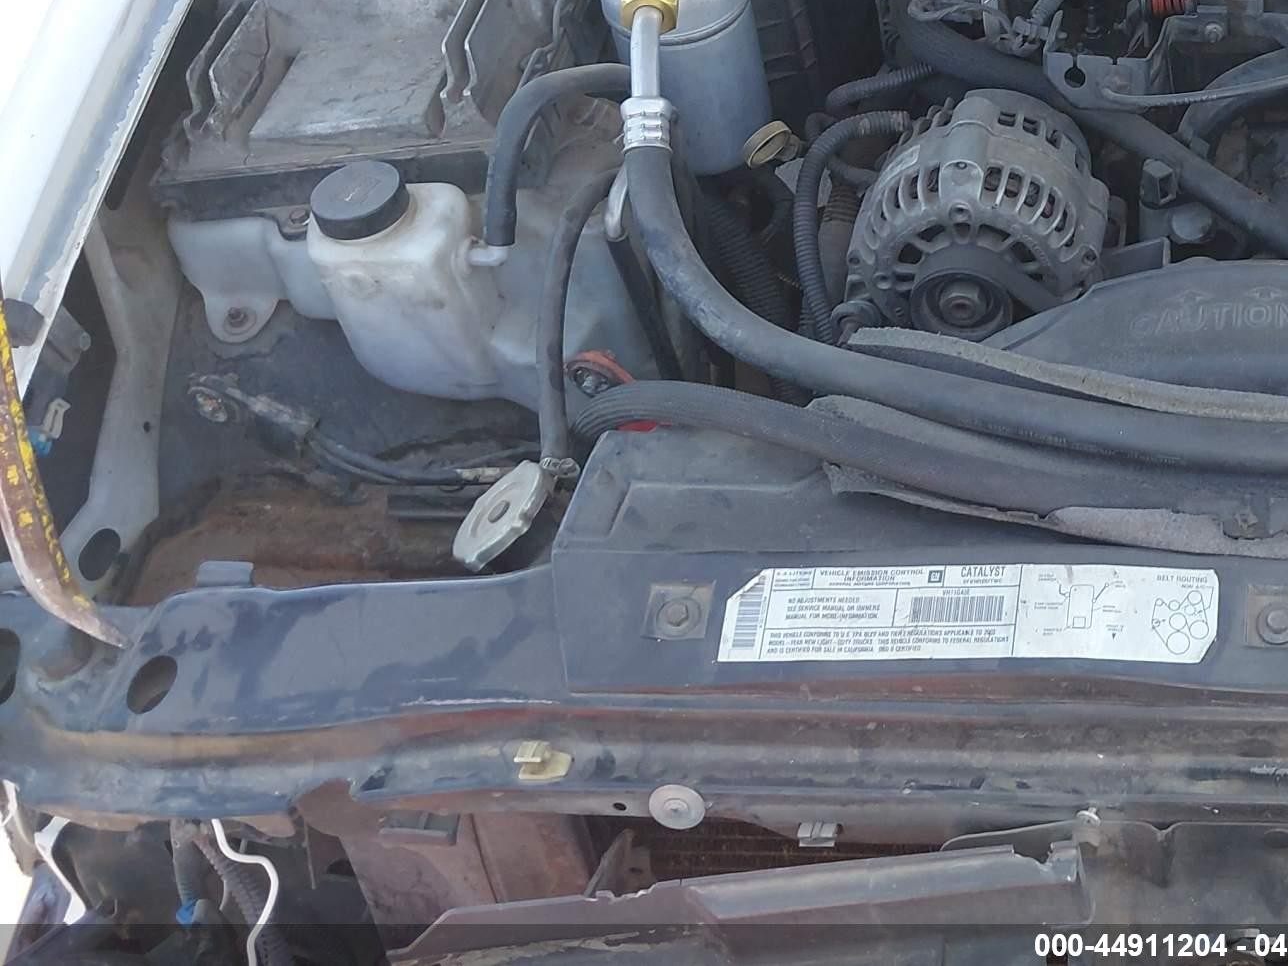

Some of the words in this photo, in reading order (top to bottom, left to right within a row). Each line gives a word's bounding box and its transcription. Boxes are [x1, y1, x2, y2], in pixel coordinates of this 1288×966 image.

[961, 566, 1006, 578] CATALYST
[1177, 575, 1208, 583] ROUTING
[797, 596, 836, 604] ADJUSTMENTS
[822, 604, 844, 612] MANUAL
